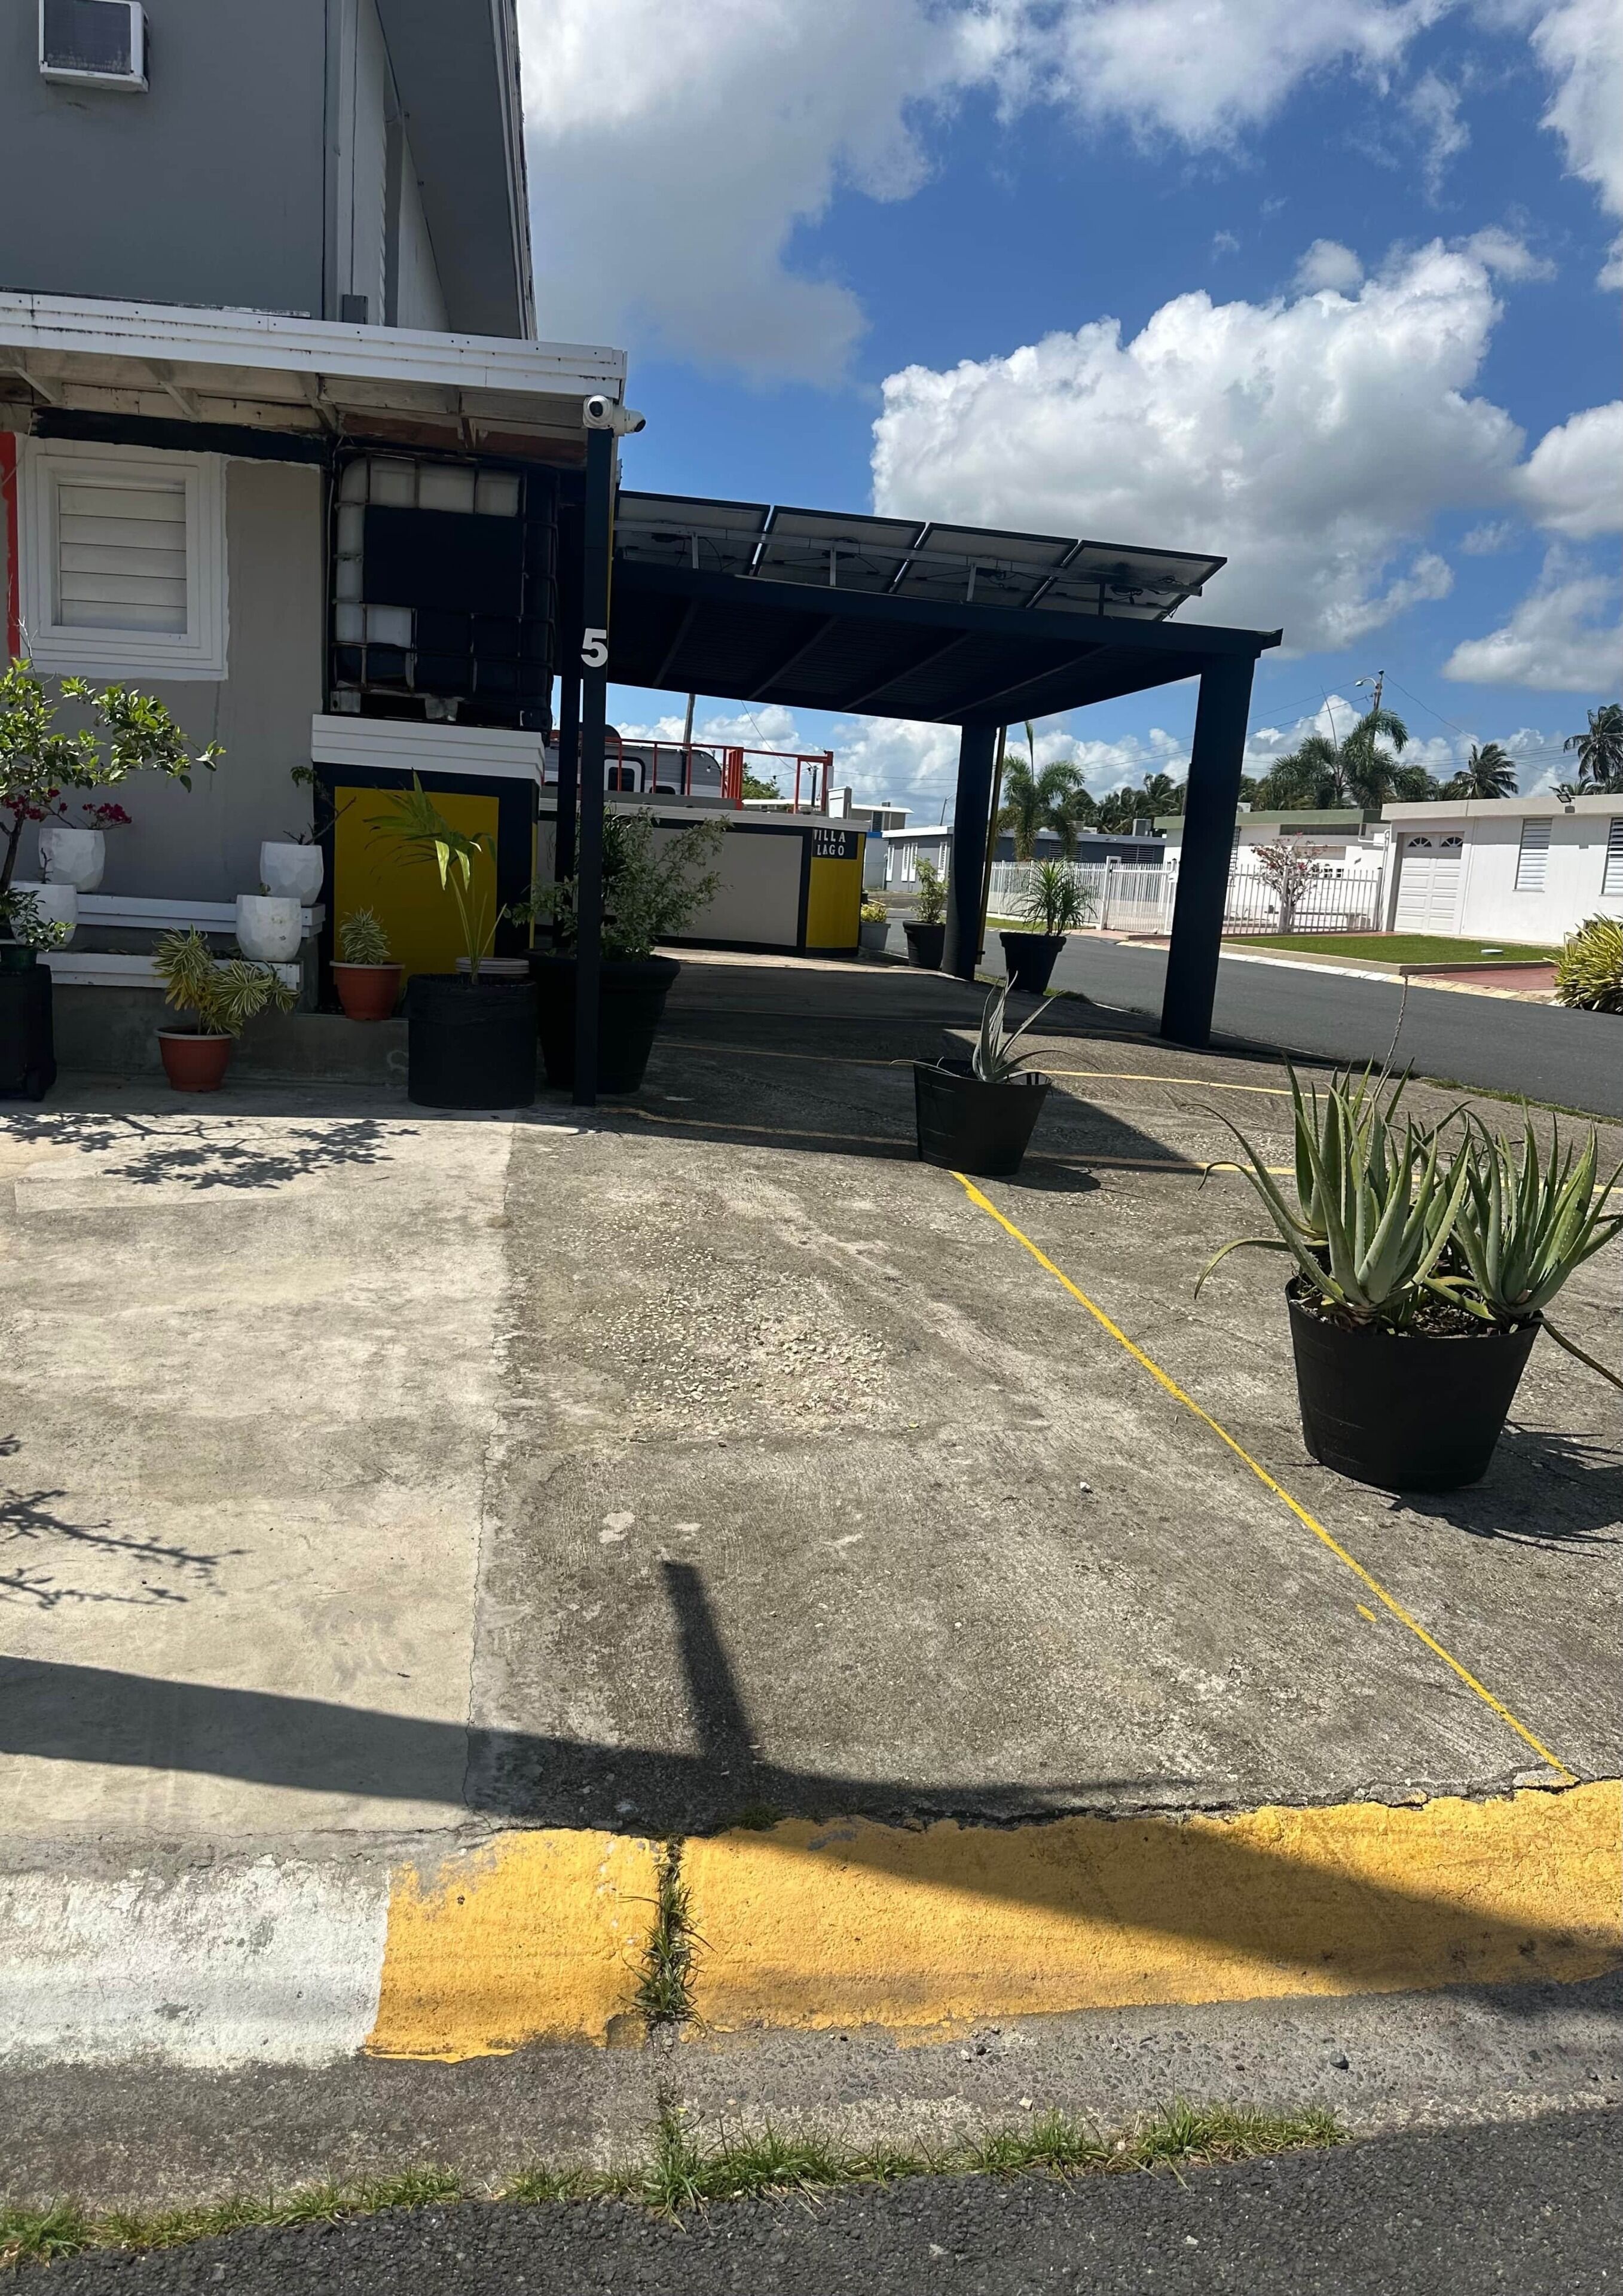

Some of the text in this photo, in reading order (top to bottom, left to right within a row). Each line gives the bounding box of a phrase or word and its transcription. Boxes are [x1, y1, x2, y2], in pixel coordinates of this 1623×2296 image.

[580, 628, 608, 667] 5
[814, 829, 846, 842] VILLA
[817, 844, 845, 856] LAGO
